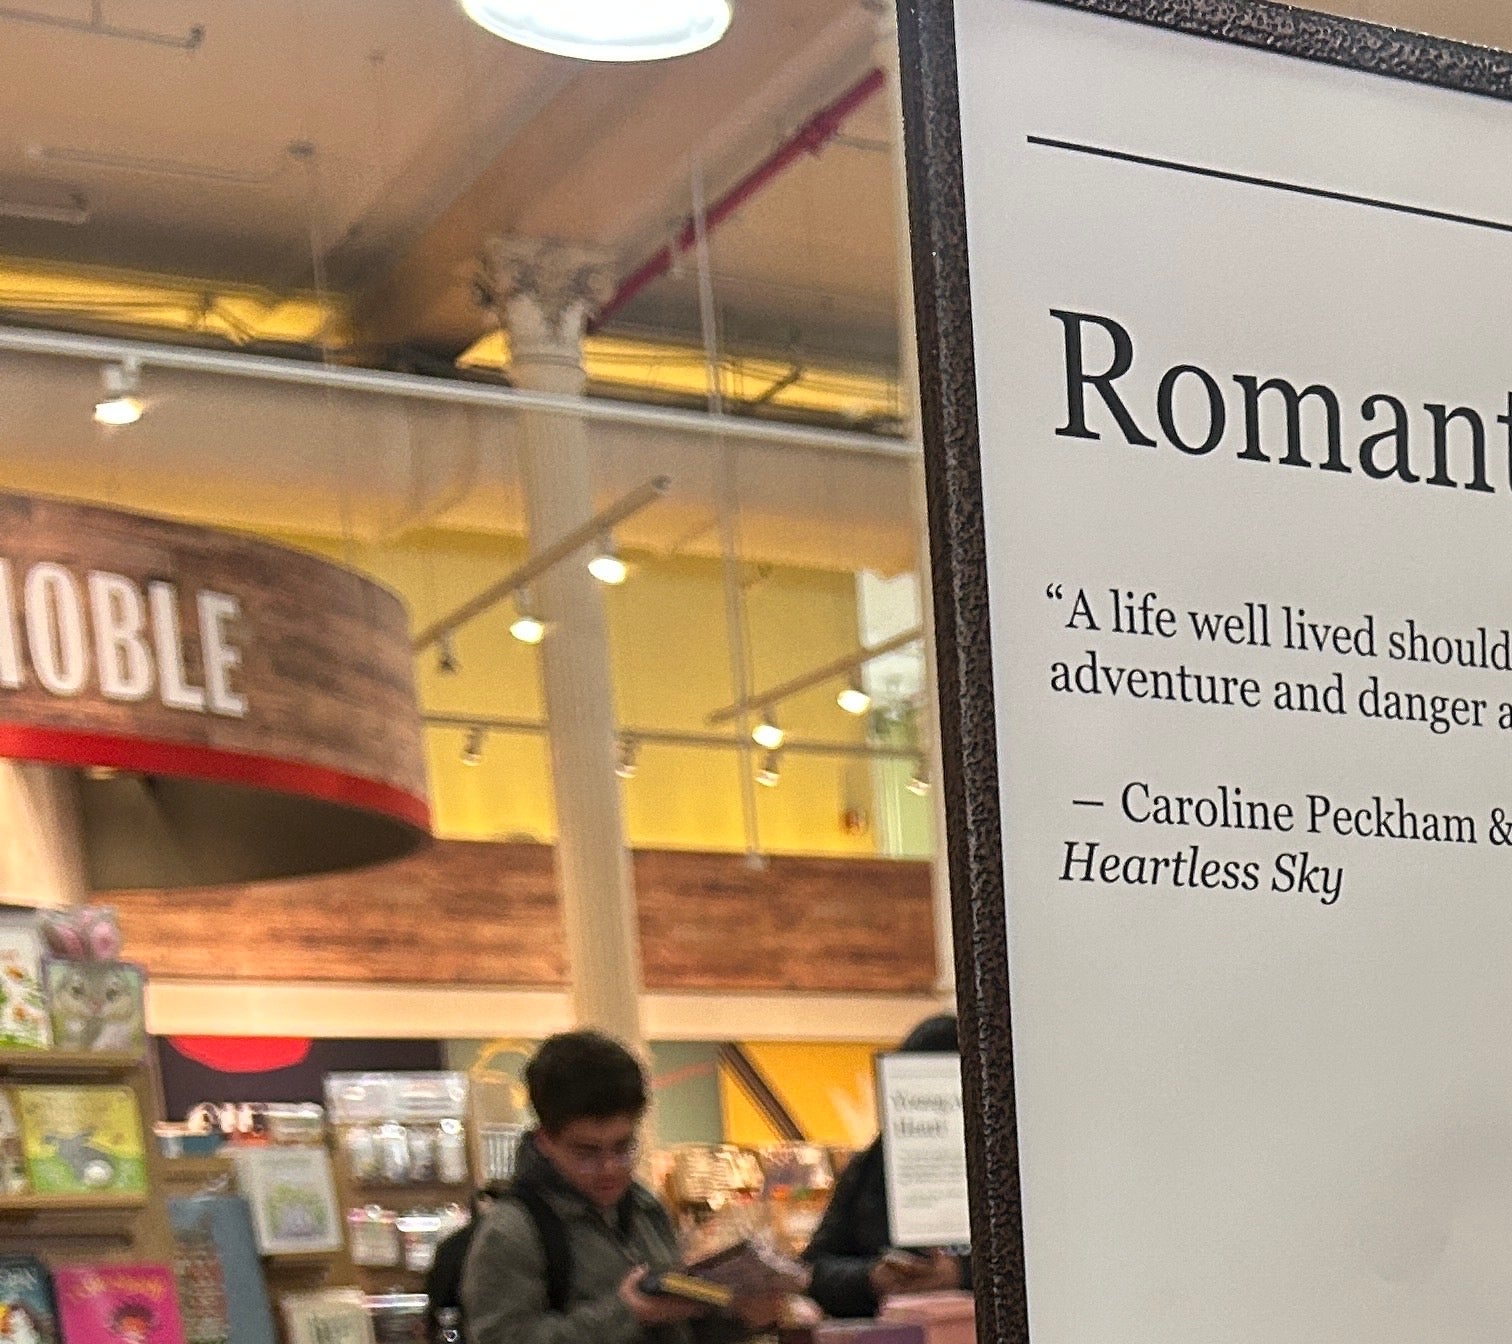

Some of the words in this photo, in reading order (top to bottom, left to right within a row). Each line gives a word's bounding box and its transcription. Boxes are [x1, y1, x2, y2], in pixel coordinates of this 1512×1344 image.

[1110, 588, 1177, 638] life
[1188, 602, 1271, 647] well
[1283, 606, 1377, 657] lived
[1388, 619, 1512, 671] should
[1050, 651, 1261, 708] adventure
[1273, 672, 1347, 714] and
[1358, 676, 1487, 734] danger
[1120, 781, 1295, 832] Caroline
[1306, 794, 1477, 844] Peckham
[1058, 841, 1260, 890] Heartless
[1271, 851, 1345, 905] Sky
